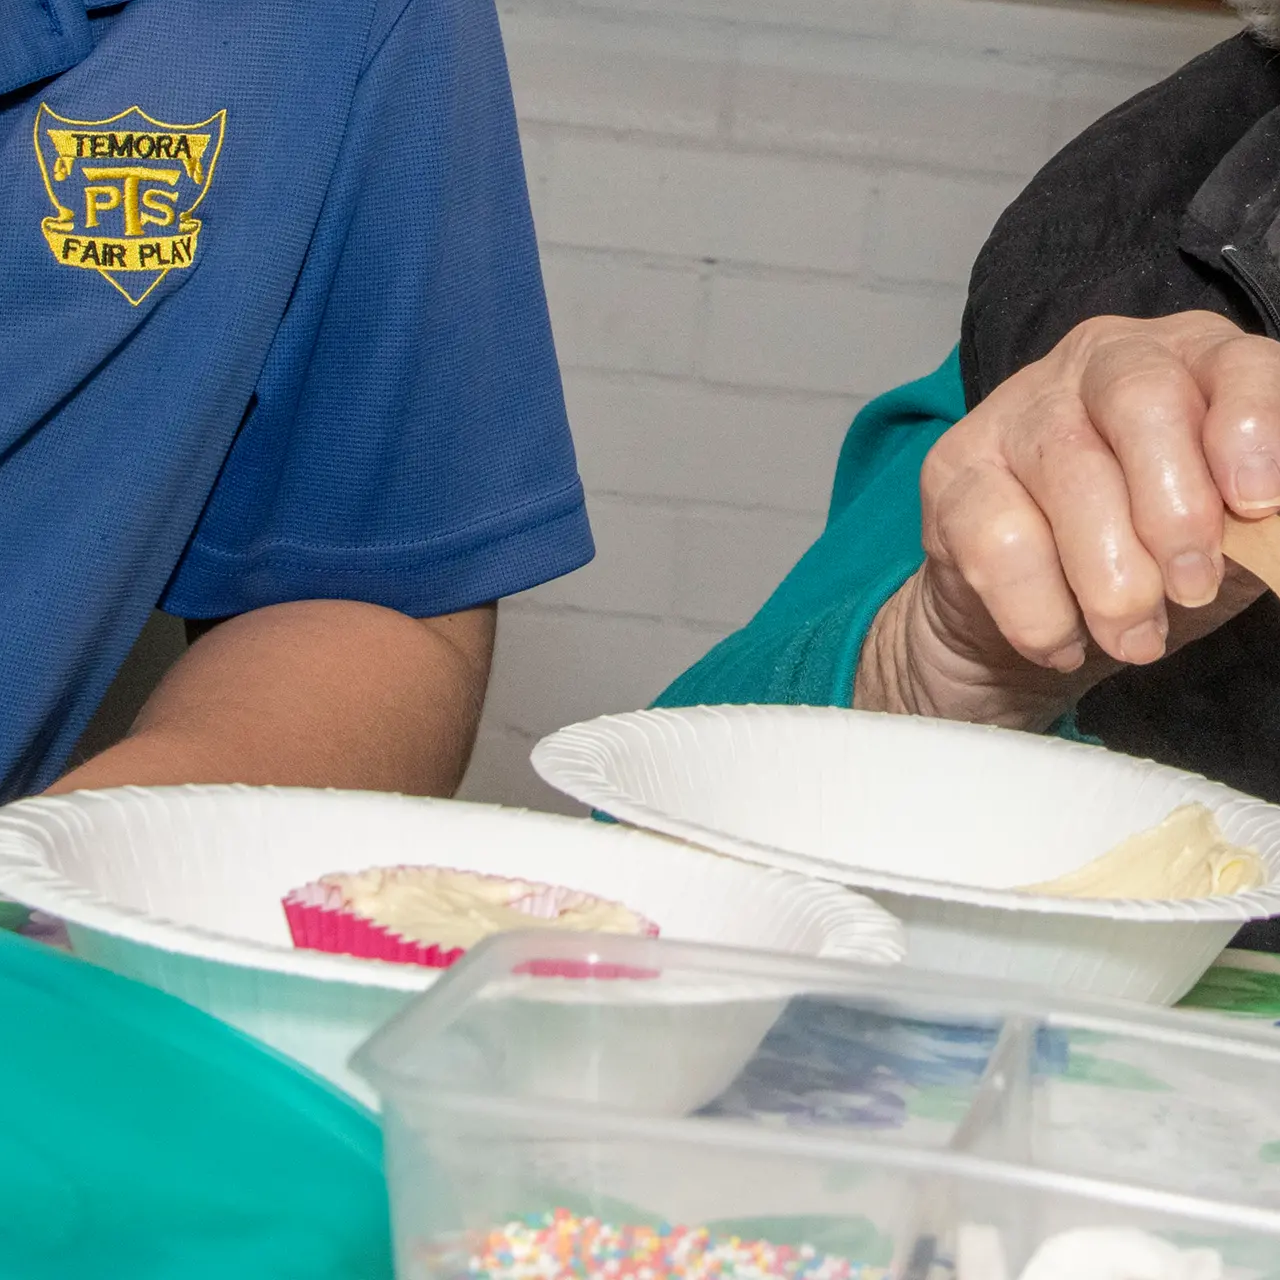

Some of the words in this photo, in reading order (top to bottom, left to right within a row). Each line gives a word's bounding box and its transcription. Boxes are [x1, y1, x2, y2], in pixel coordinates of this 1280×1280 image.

[71, 133, 192, 159] TEMORA
[62, 237, 127, 268] FAIR
[139, 236, 192, 267] PLAY
